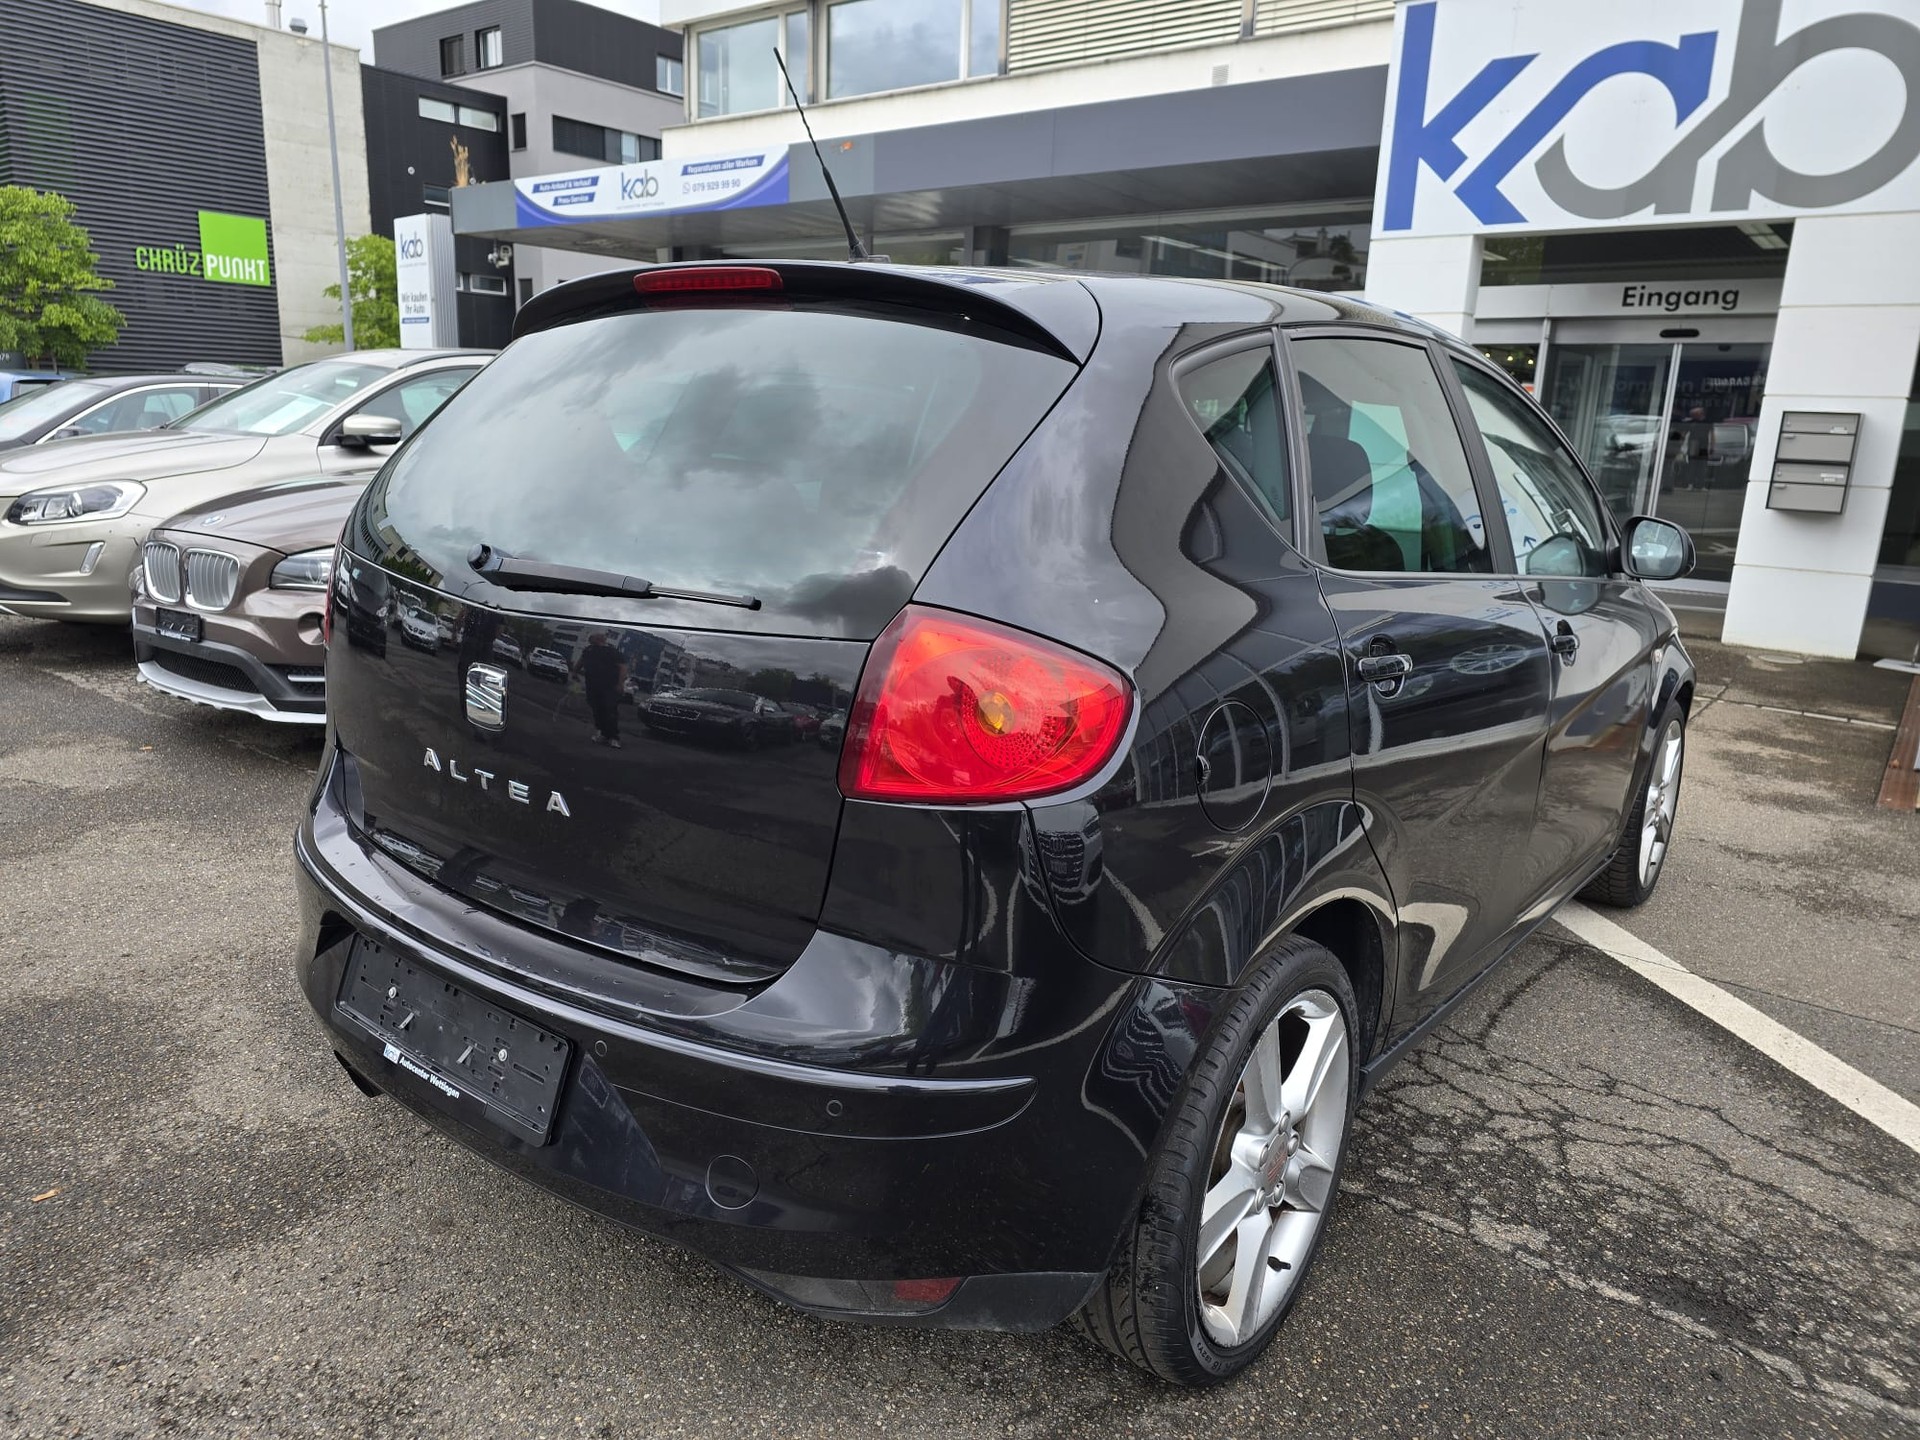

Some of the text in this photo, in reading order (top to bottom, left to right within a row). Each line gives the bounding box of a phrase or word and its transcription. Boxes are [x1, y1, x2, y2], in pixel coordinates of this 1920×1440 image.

[1383, 0, 1920, 231] kab
[621, 169, 659, 200] kab
[691, 182, 705, 192] 079
[135, 243, 265, 282] CHRÜZ PUNKT
[400, 231, 424, 259] kab
[1622, 285, 1739, 312] Eingang
[423, 747, 571, 818] ALTEA
[399, 1056, 460, 1099] Autocenter Wettingen
